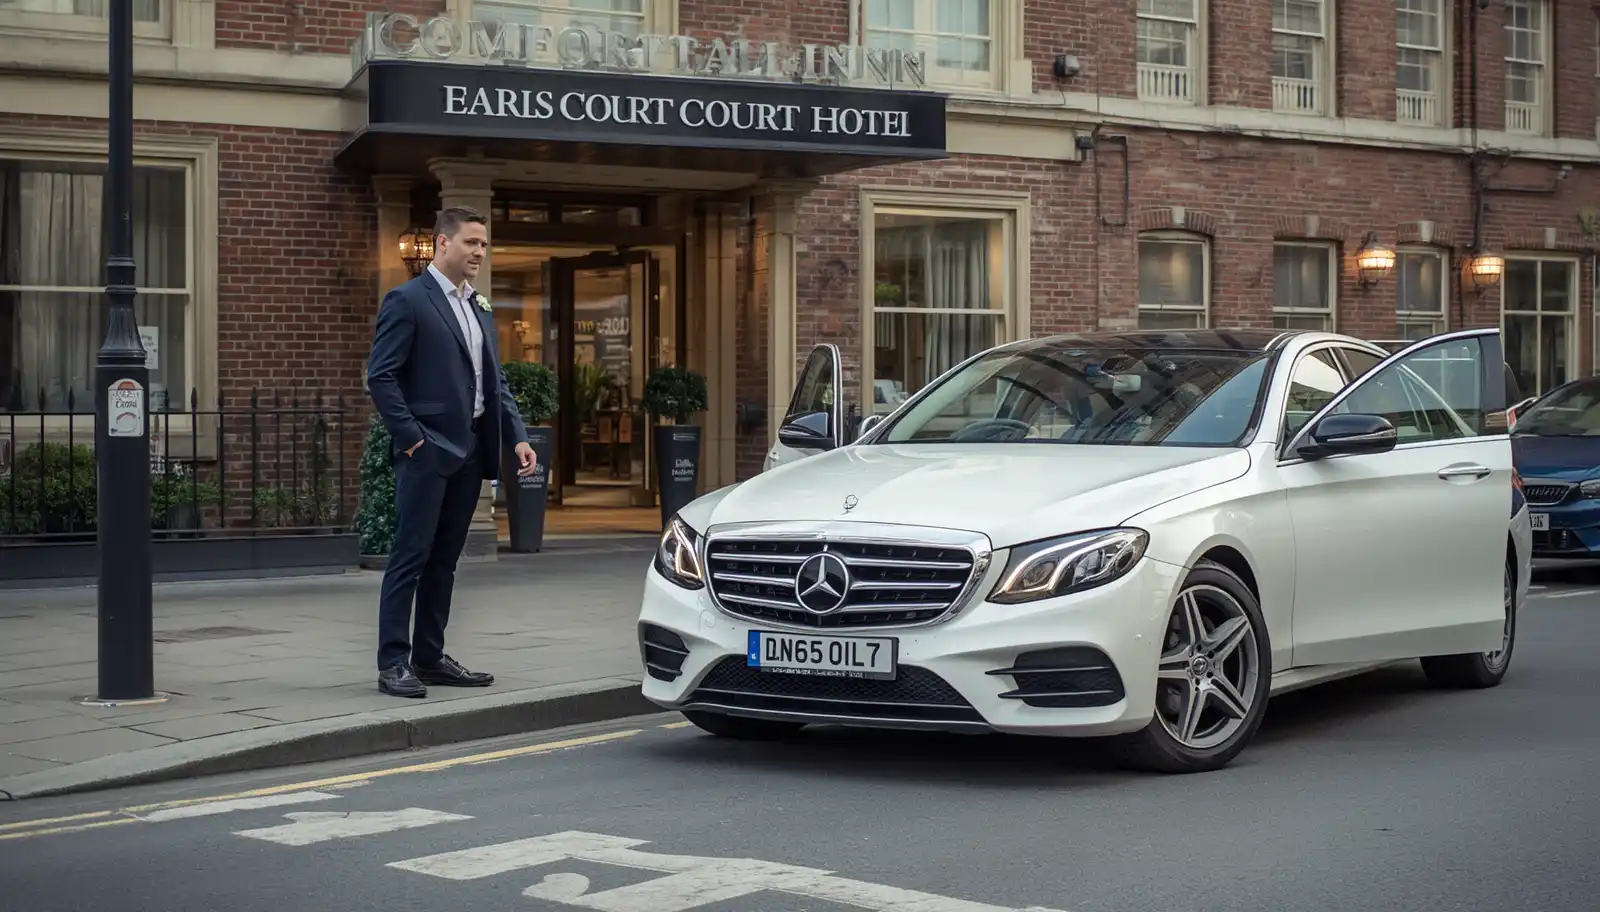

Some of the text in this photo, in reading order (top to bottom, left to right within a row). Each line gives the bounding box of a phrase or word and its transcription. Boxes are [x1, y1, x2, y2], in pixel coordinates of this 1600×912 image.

[560, 92, 674, 125] COURT
[679, 99, 800, 131] COURT
[810, 106, 912, 137] HOTEL
